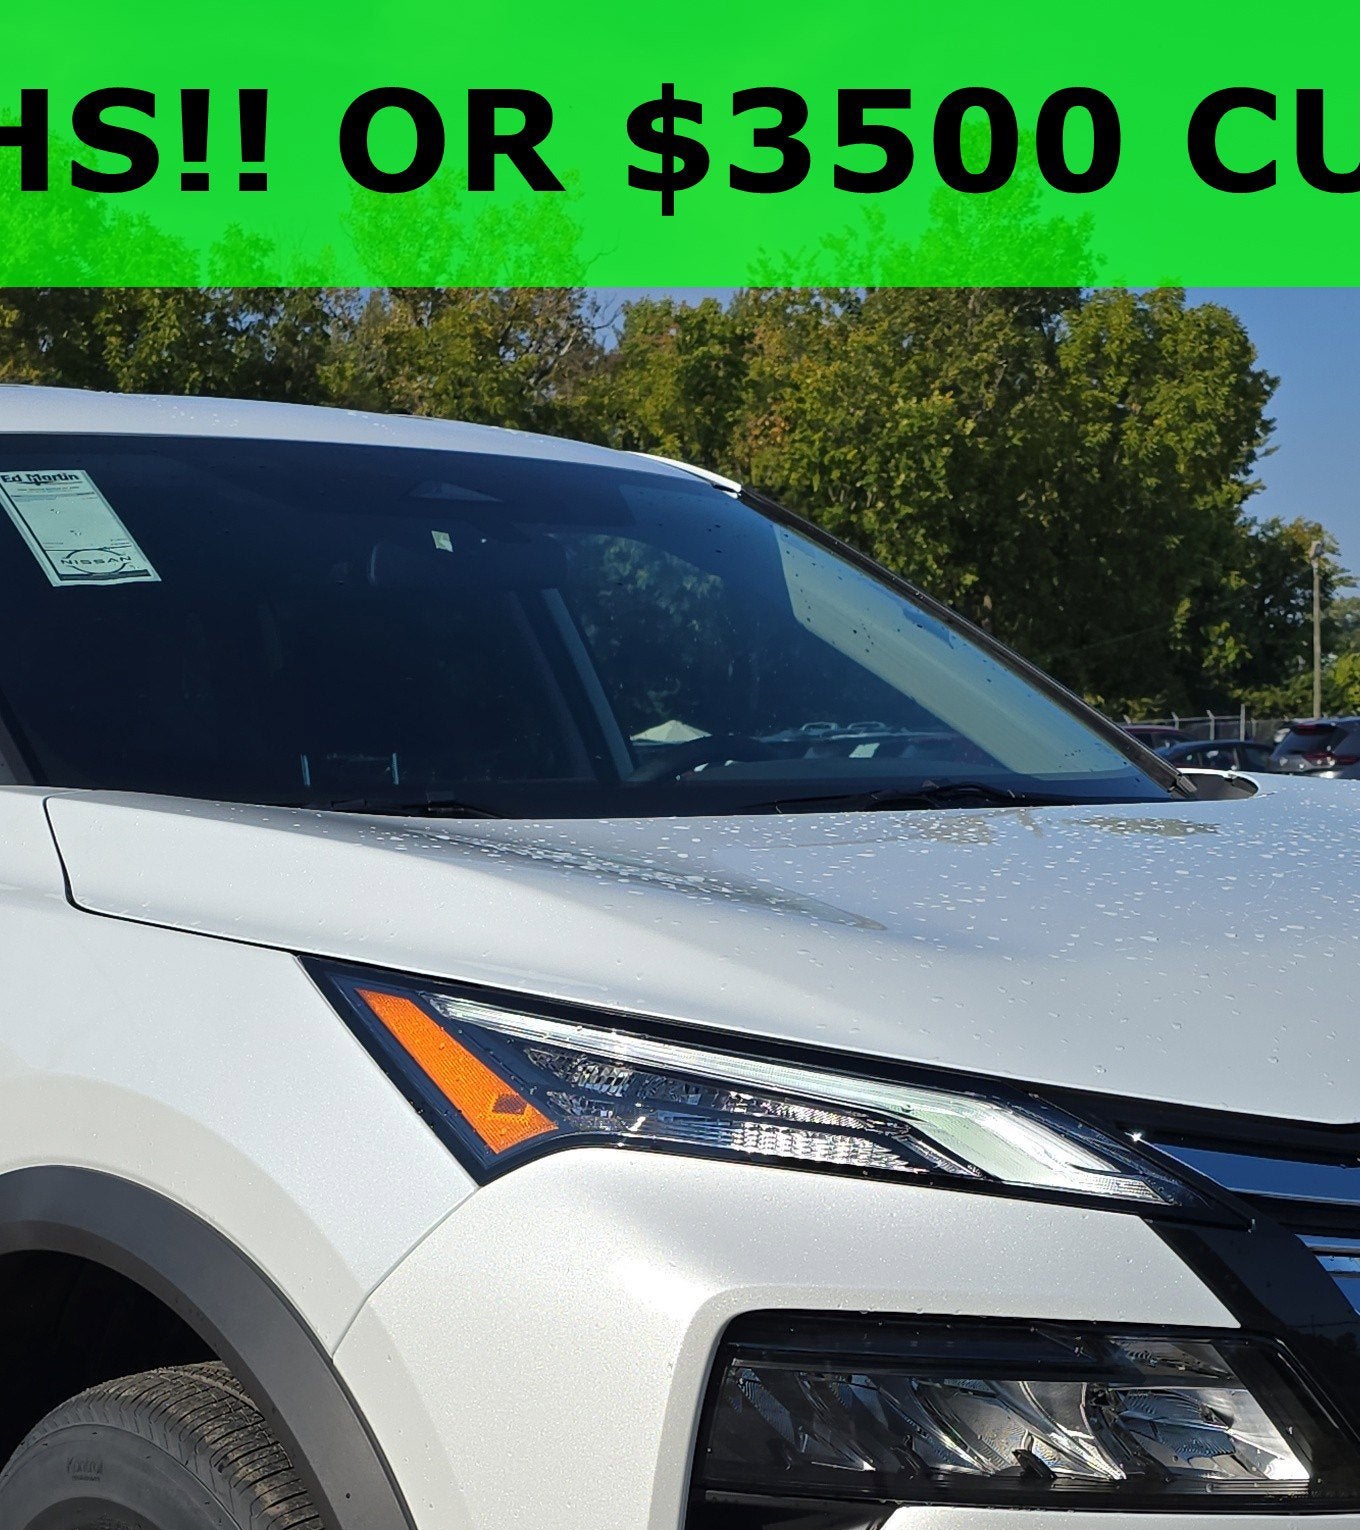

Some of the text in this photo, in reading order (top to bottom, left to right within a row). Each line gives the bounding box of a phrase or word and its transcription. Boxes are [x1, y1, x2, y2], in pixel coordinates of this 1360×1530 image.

[0, 472, 80, 486] Ed Martin
[60, 555, 132, 565] NISSAN
